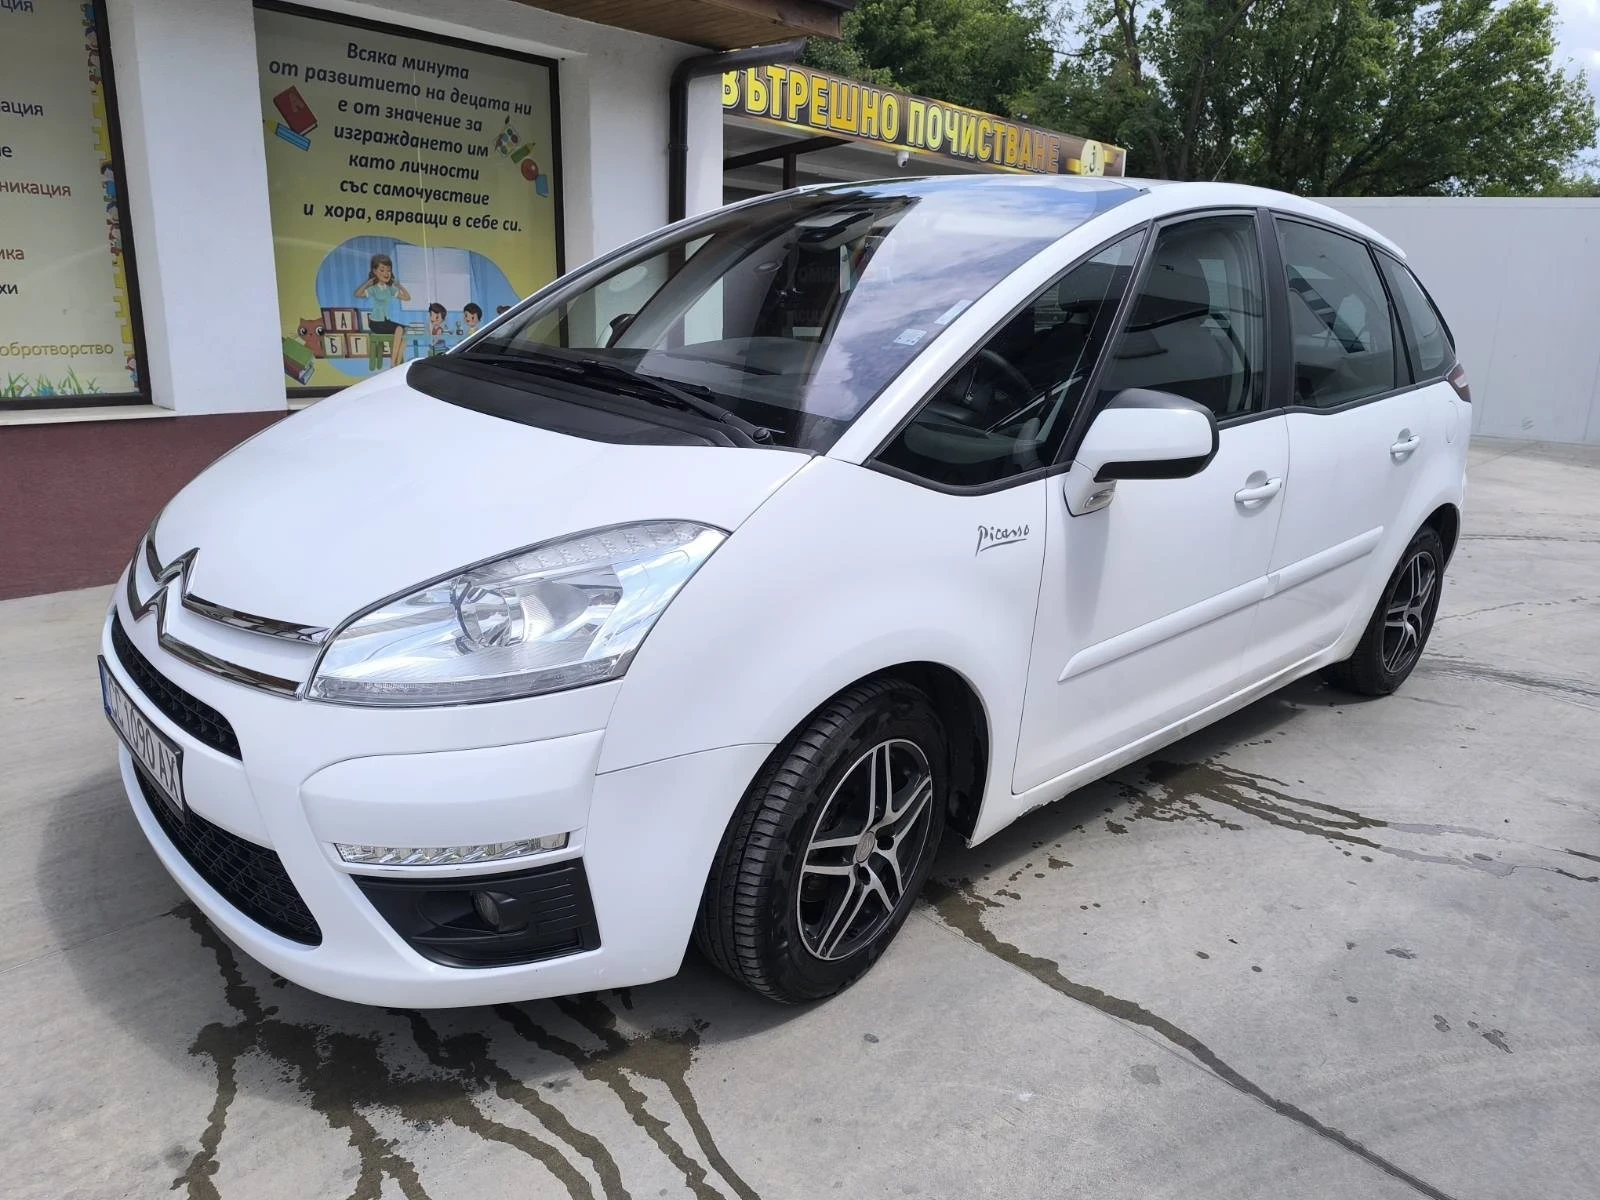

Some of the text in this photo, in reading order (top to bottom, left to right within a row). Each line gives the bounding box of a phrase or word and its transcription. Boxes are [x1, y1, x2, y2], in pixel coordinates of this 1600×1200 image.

[347, 42, 470, 80] Всяка минута
[268, 60, 532, 116] от развитието на децата ни
[338, 99, 483, 132] е от значение за
[722, 63, 1060, 175] ВЪТРЕШНО ПОЧИСТВАНЕ
[334, 125, 489, 157] изграждането им
[349, 154, 480, 181] като личности
[340, 179, 490, 206] със самочувствие
[303, 203, 522, 232] и хора, вярващи в себе си.
[975, 524, 1030, 557] Picasso
[124, 703, 155, 769] 1090
[158, 742, 179, 798] AX
